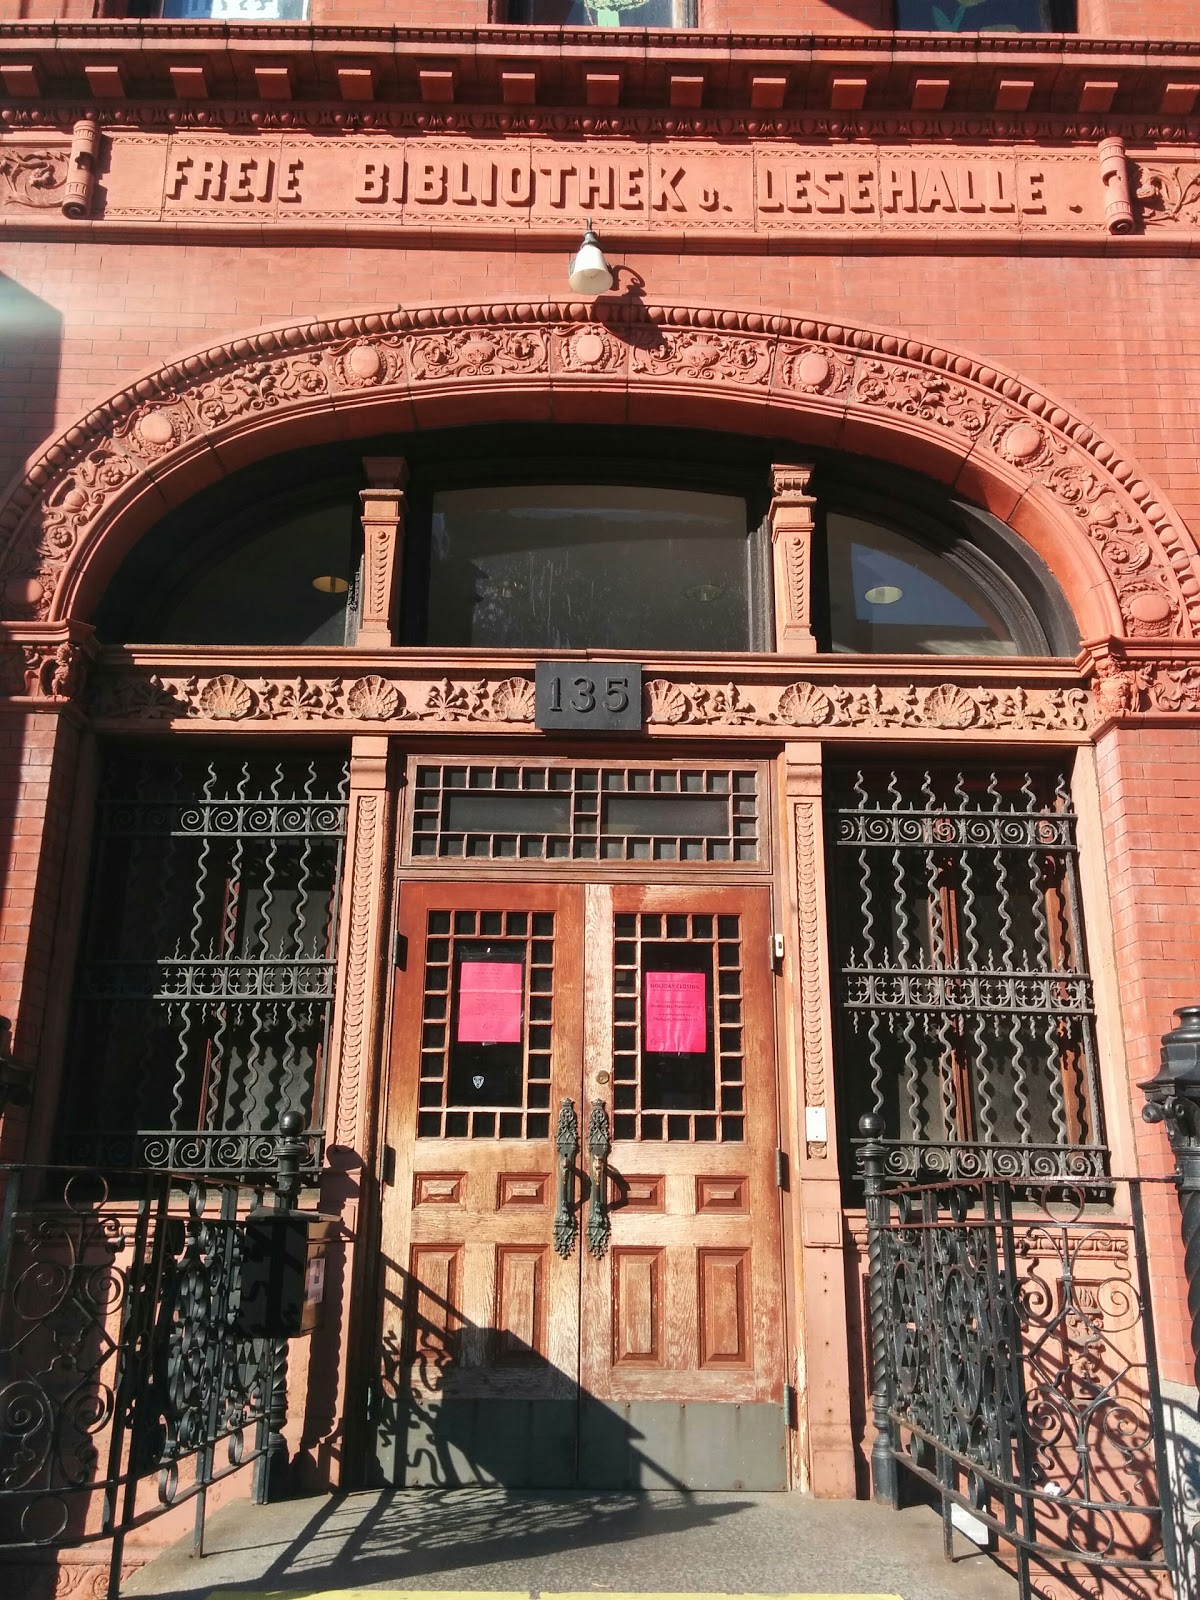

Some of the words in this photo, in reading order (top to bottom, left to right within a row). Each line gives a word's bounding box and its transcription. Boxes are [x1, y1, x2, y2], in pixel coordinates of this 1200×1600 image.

[165, 156, 304, 203] FREIE
[355, 160, 687, 212] BIBLIOTHEK
[549, 676, 629, 713] 135
